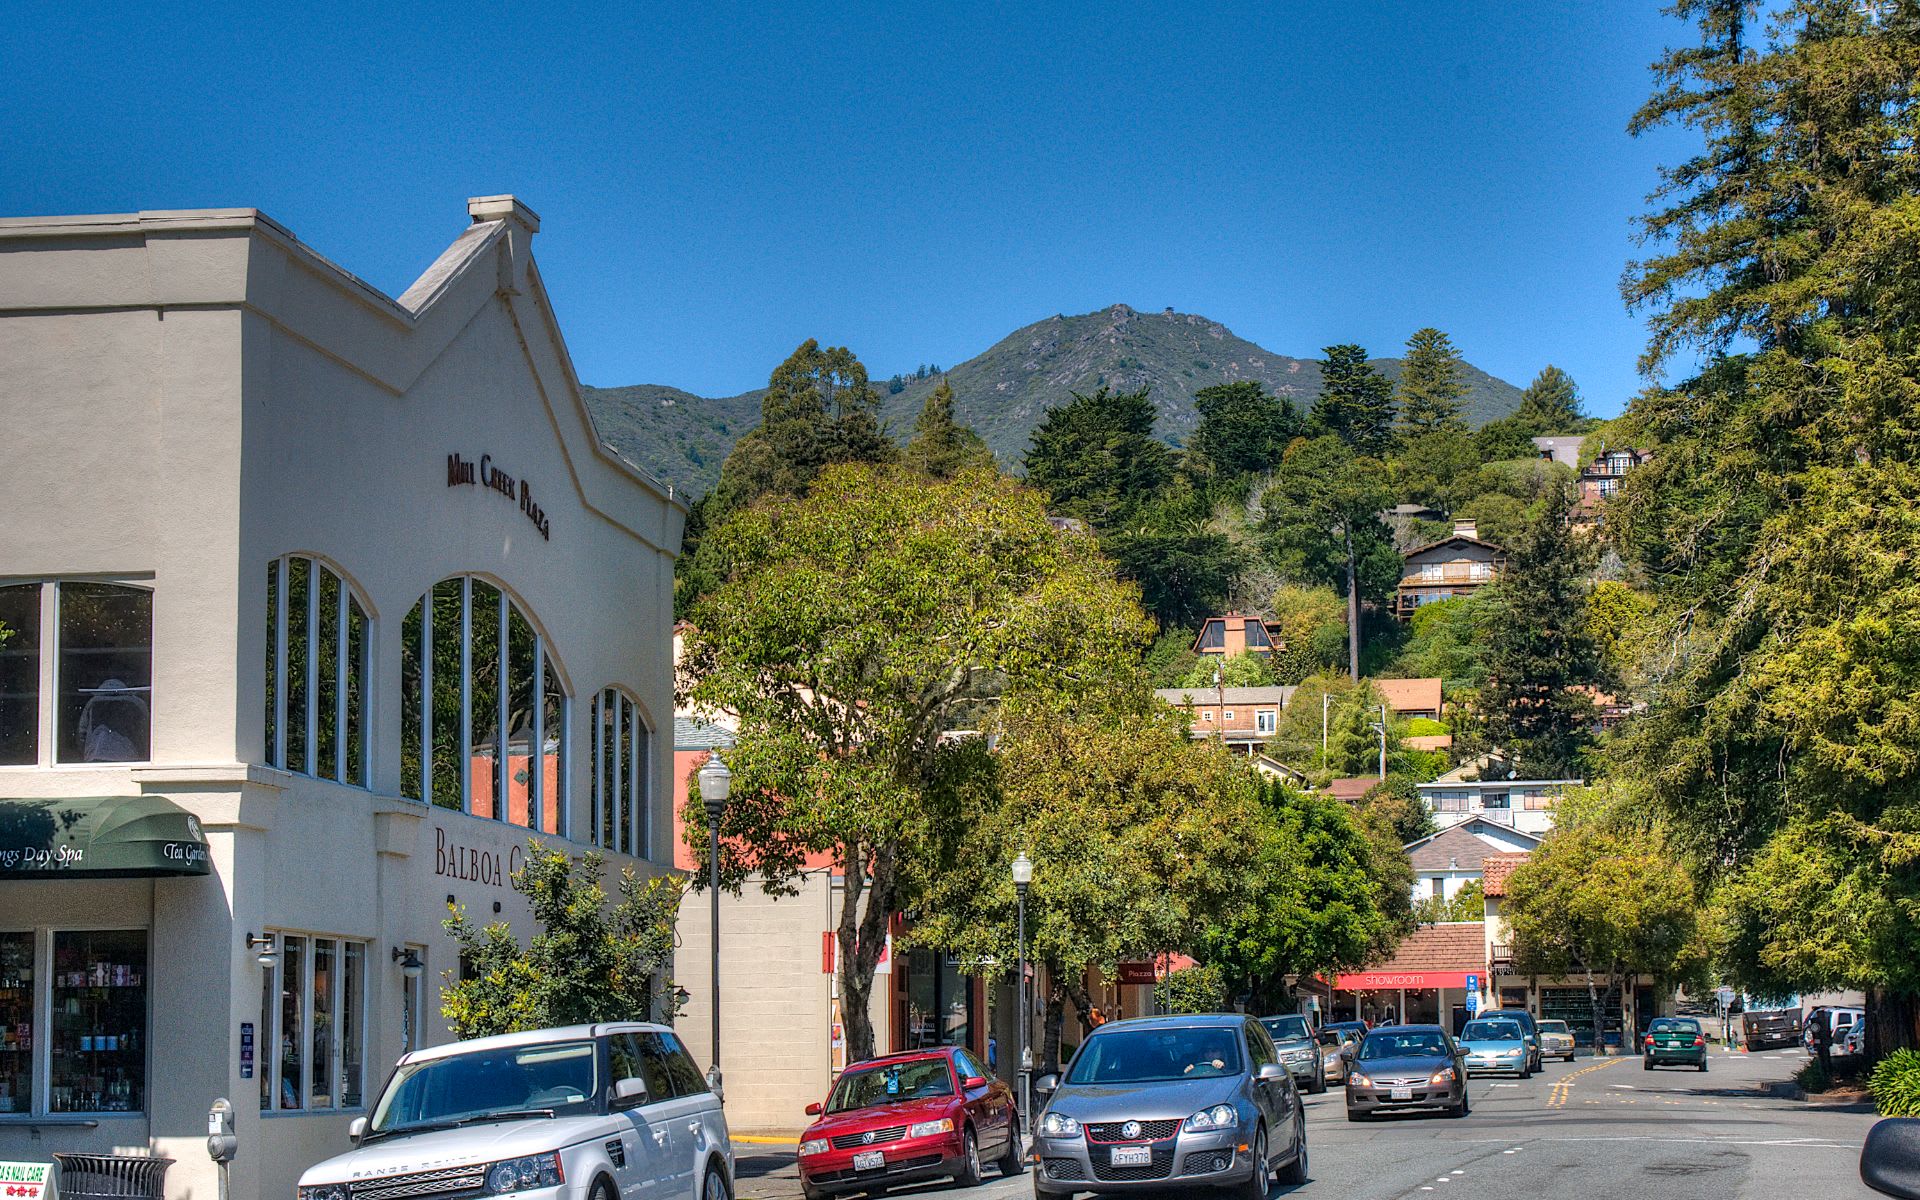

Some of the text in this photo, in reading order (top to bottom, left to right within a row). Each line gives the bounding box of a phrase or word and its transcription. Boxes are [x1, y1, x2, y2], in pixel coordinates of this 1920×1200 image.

[23, 846, 52, 868] Day
[54, 844, 84, 867] Spa
[163, 843, 183, 860] Tea
[435, 827, 502, 887] BALBOA
[1365, 974, 1424, 985] showroom
[1114, 1152, 1150, 1164] 6FYH378
[11, 1166, 26, 1181] NAIL
[27, 1166, 45, 1182] CARE
[352, 1165, 409, 1178] RANGE
